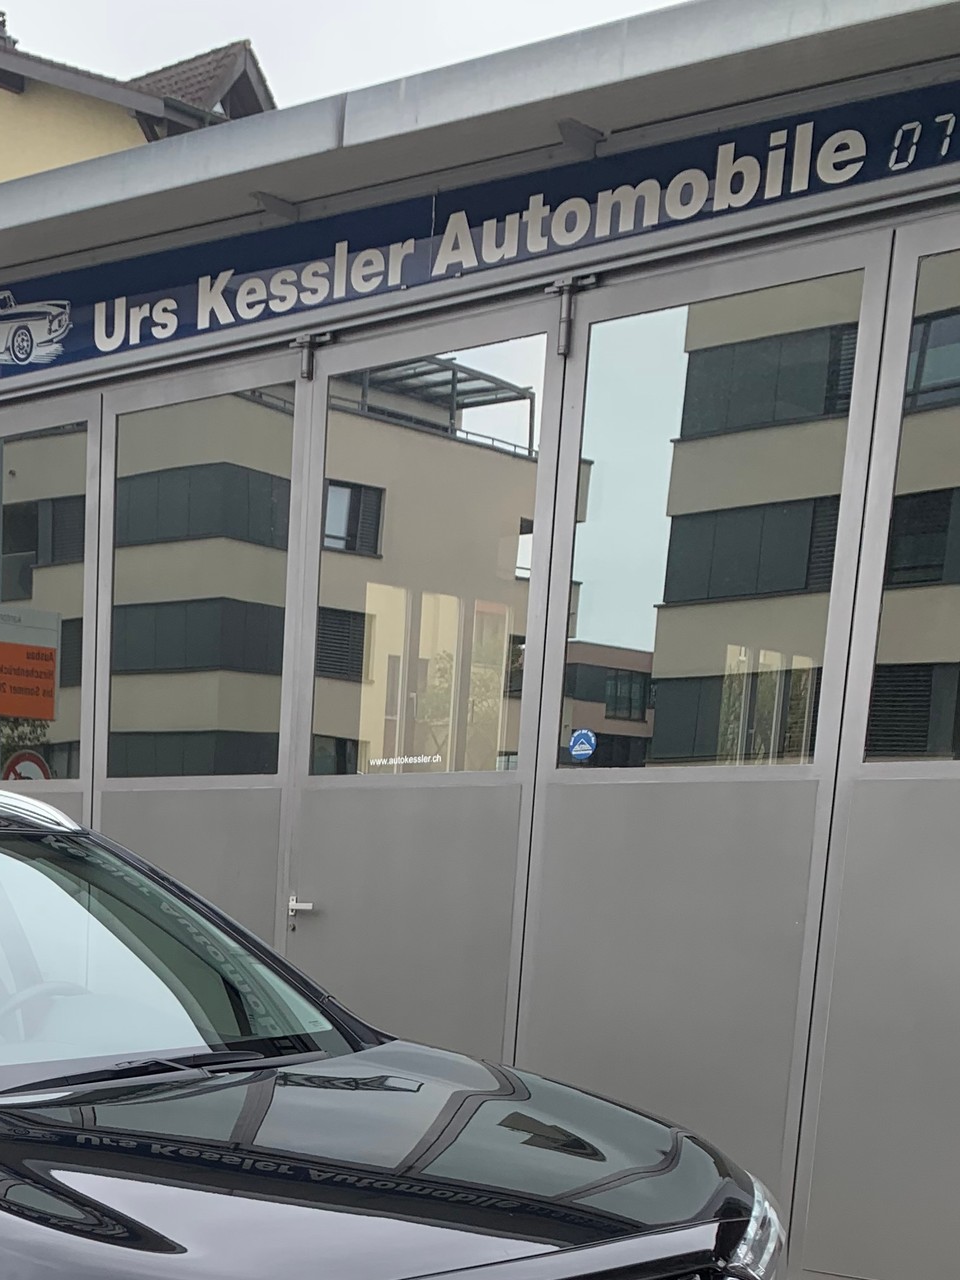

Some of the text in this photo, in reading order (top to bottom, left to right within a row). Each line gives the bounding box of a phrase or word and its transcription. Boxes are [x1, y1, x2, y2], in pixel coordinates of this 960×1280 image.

[93, 112, 957, 352] Urs Kessler Automobile 07
[369, 753, 442, 767] www.autokessler.ch
